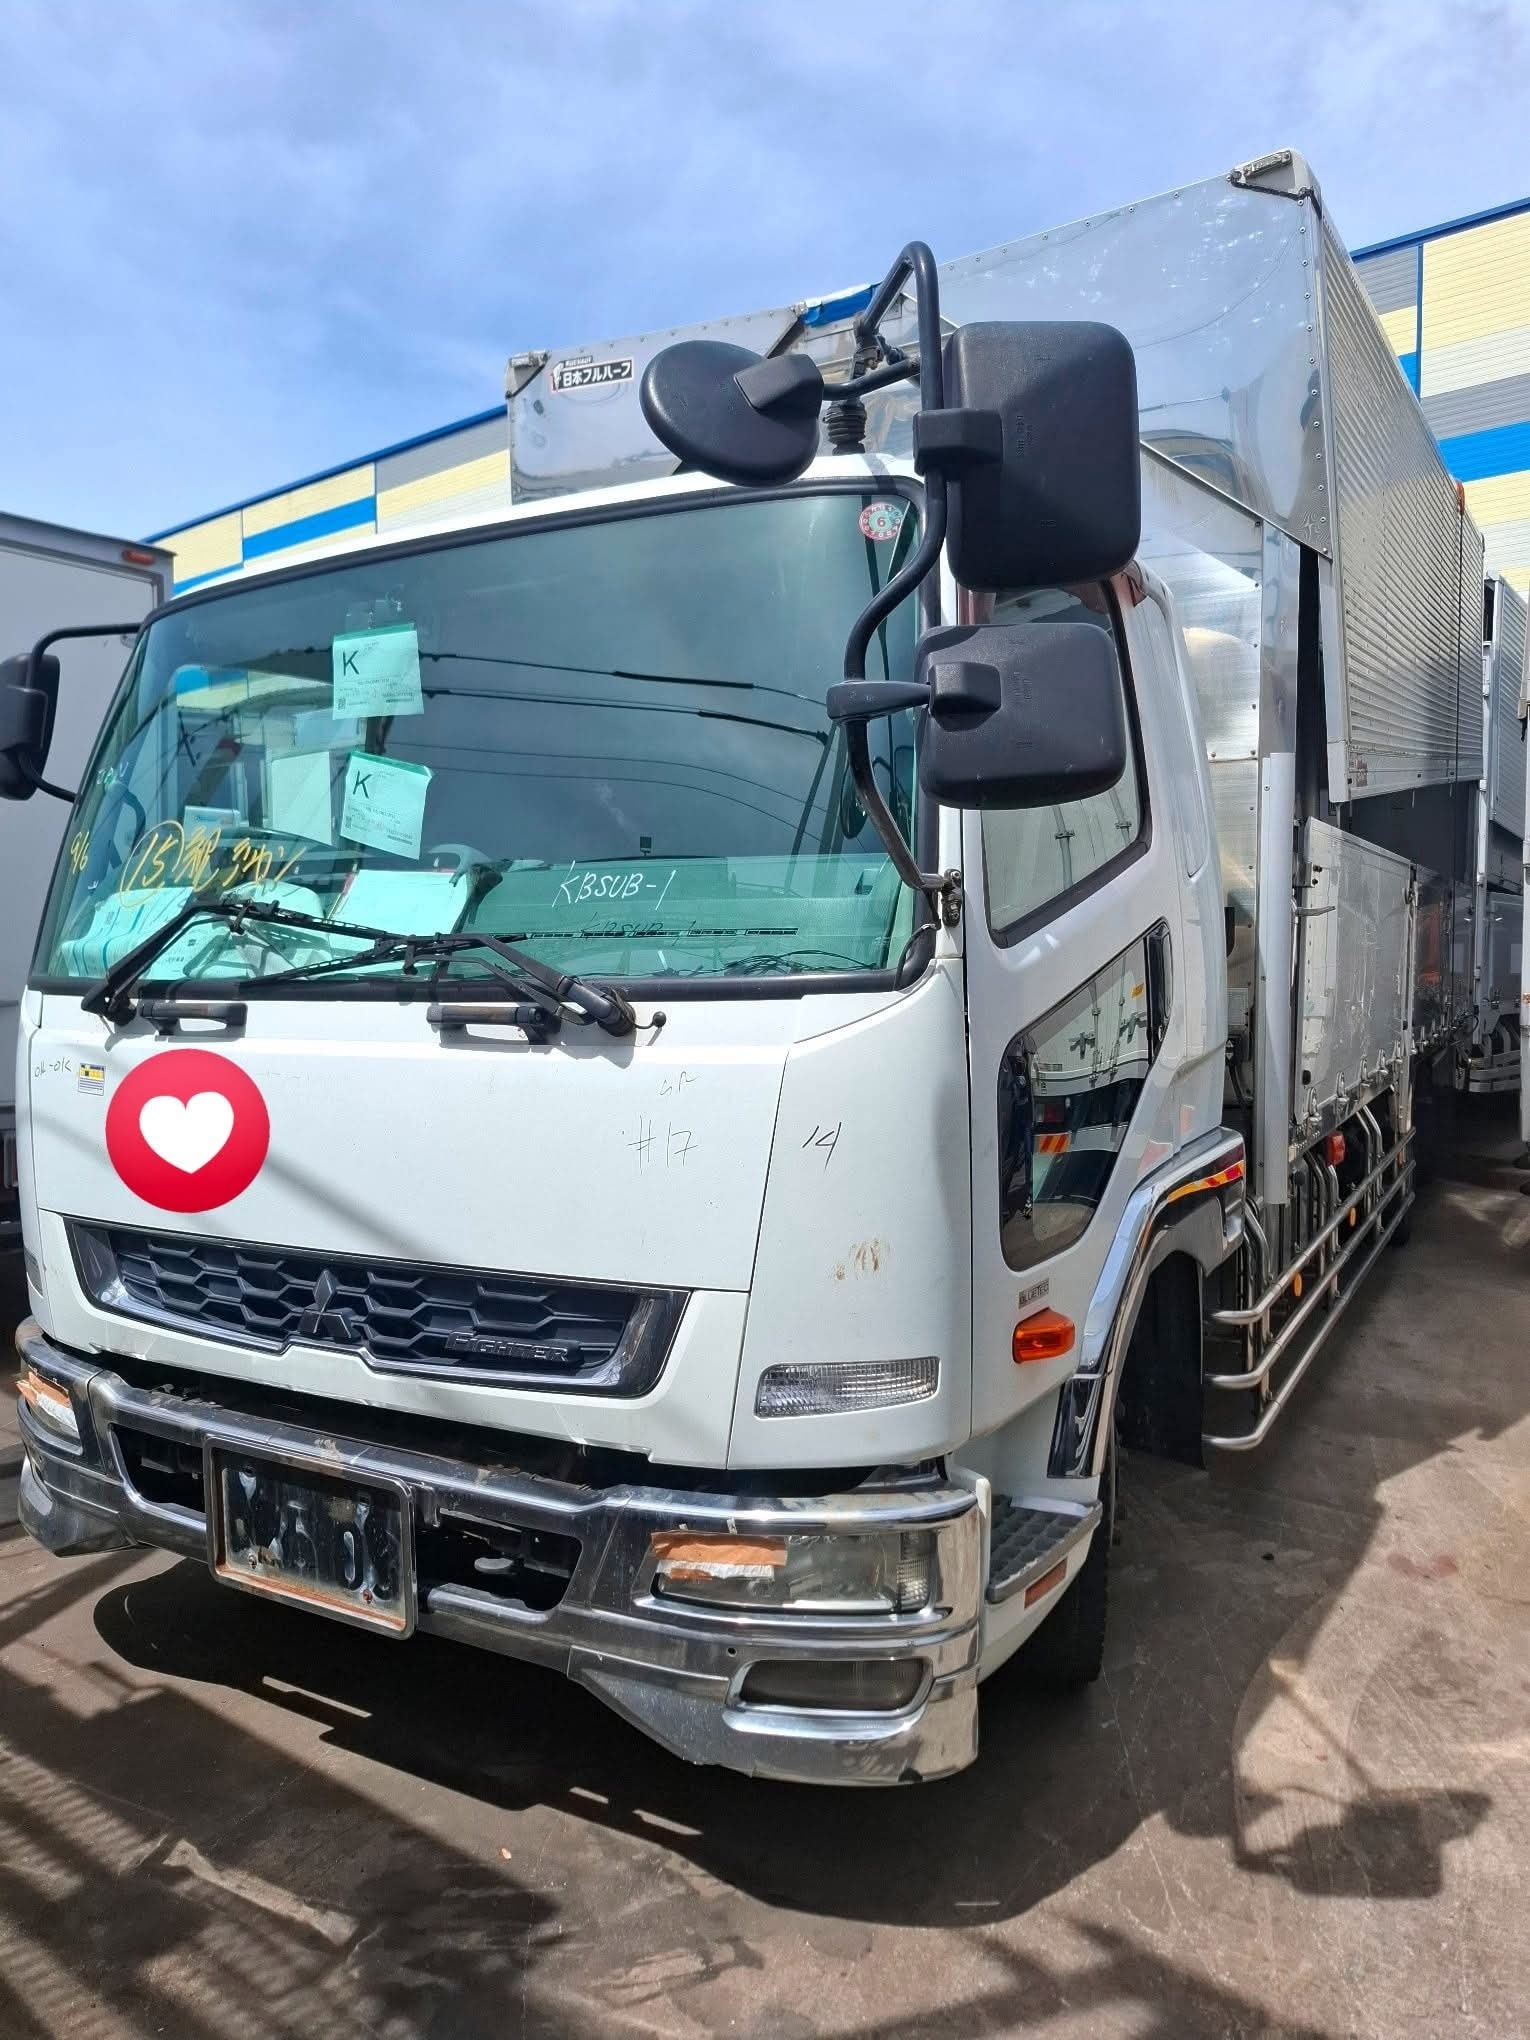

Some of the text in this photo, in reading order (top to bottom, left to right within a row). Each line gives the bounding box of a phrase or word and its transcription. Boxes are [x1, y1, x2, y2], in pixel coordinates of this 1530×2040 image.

[562, 361, 631, 388] 日本フルハーフ
[342, 650, 359, 676] K
[352, 770, 372, 799] K
[551, 860, 677, 910] KBSUB-1
[802, 1121, 842, 1171] 14
[446, 1331, 568, 1362] FIGHTER
